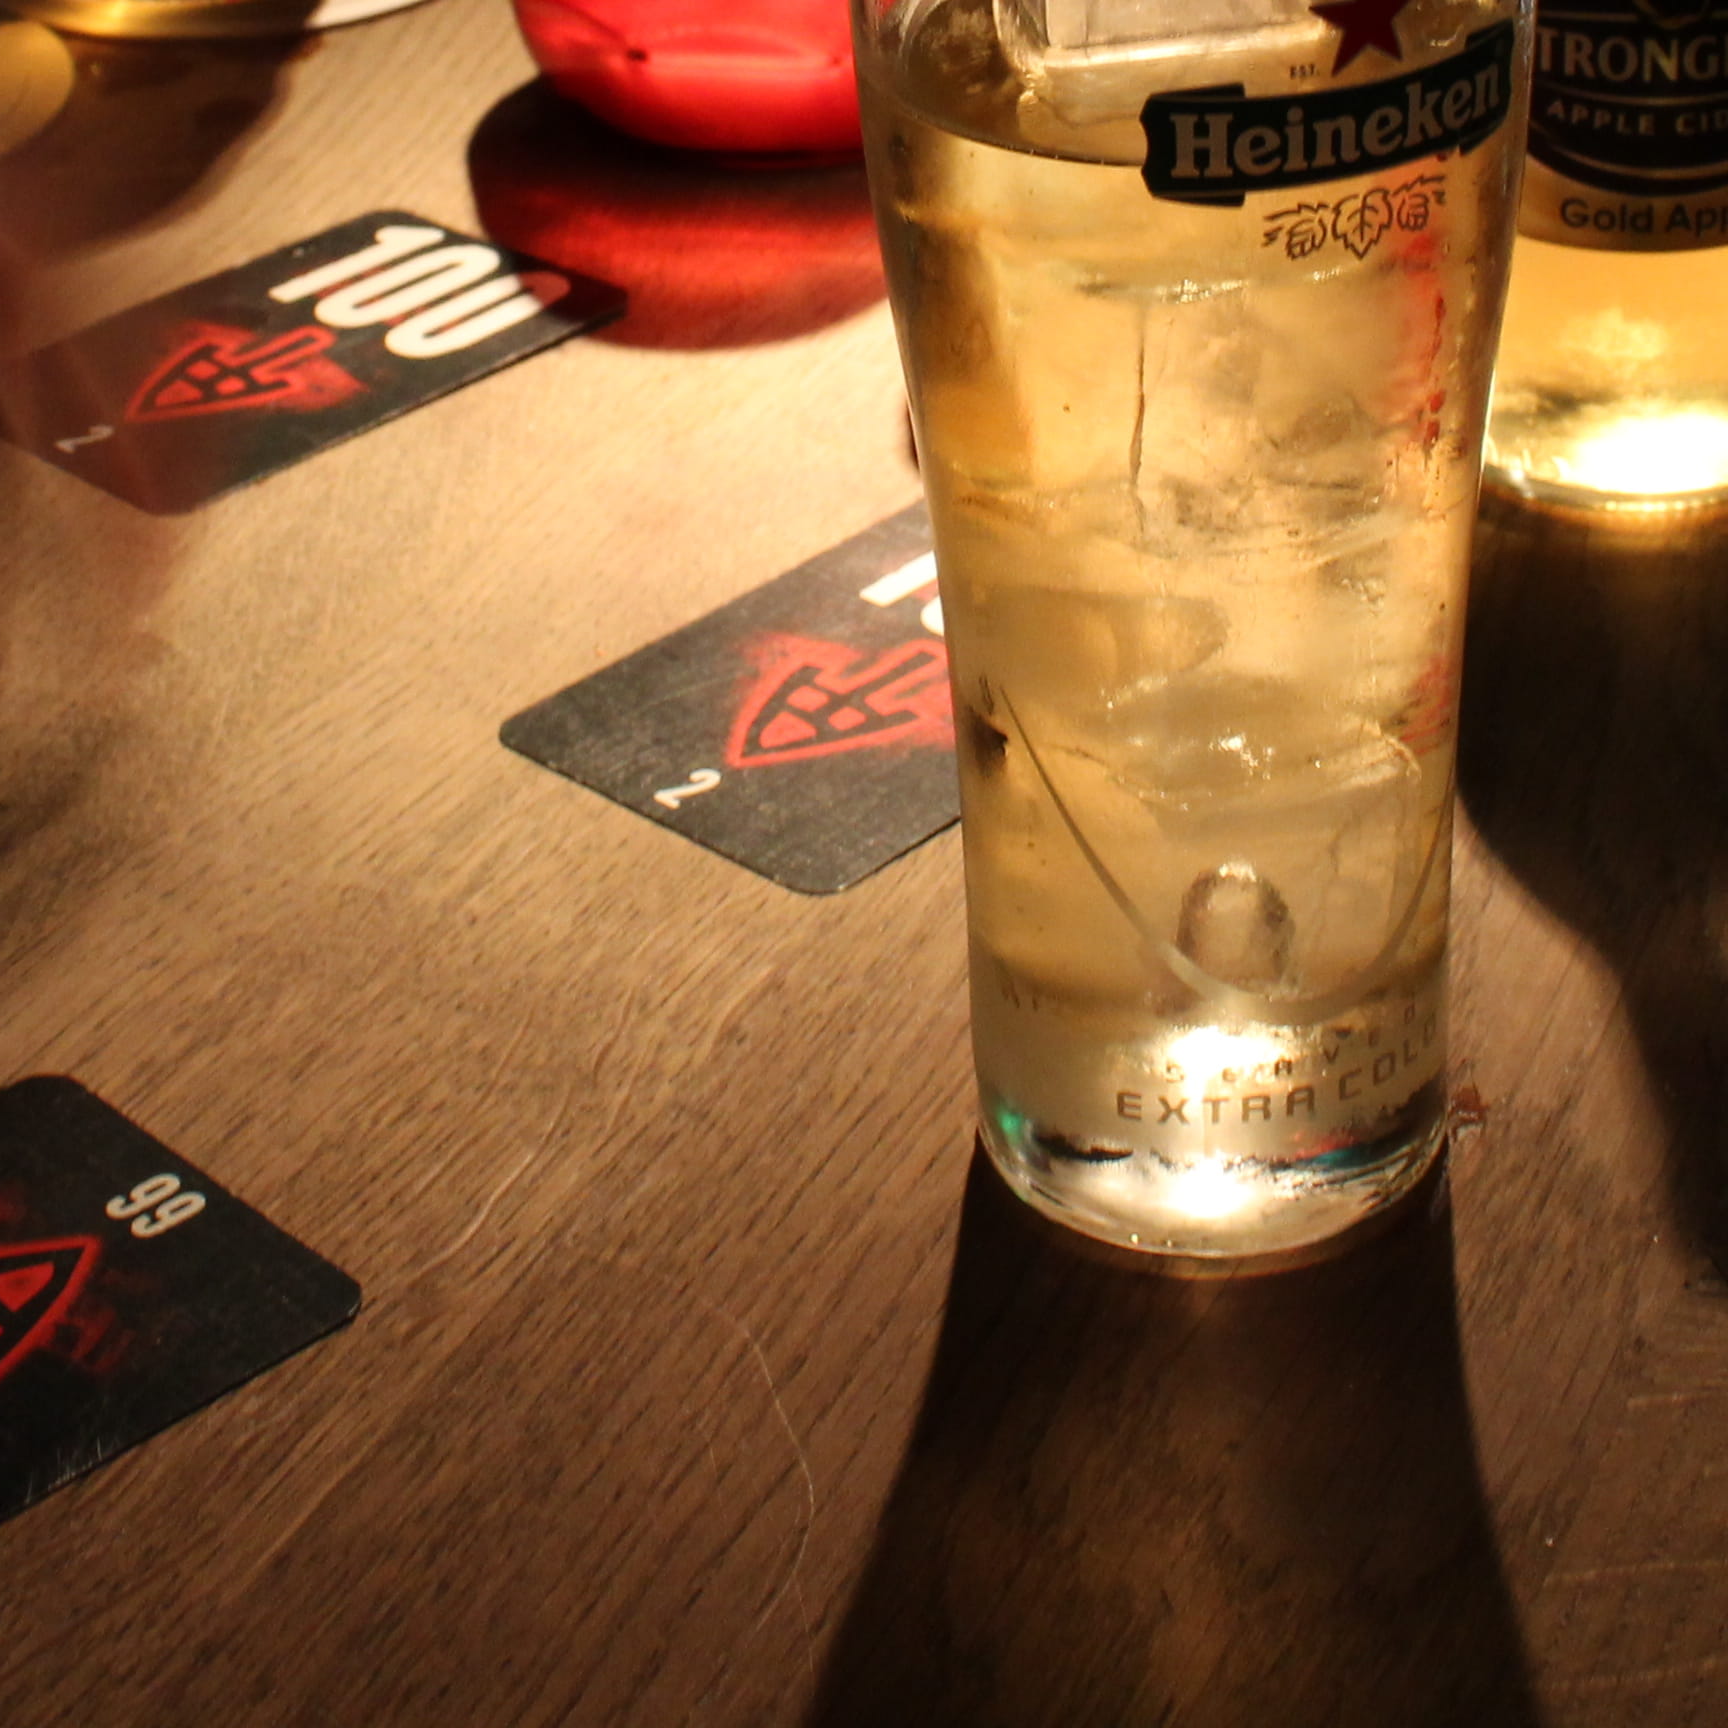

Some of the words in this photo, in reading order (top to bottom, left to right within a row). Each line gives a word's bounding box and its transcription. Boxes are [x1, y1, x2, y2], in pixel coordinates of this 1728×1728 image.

[1168, 62, 1502, 180] Heineken
[1545, 95, 1657, 137] APPLE
[1559, 197, 1654, 235] Gold
[268, 223, 573, 361] 100
[652, 767, 723, 810] 2
[1115, 1084, 1316, 1126] EXTRA
[105, 1171, 209, 1241] 99
